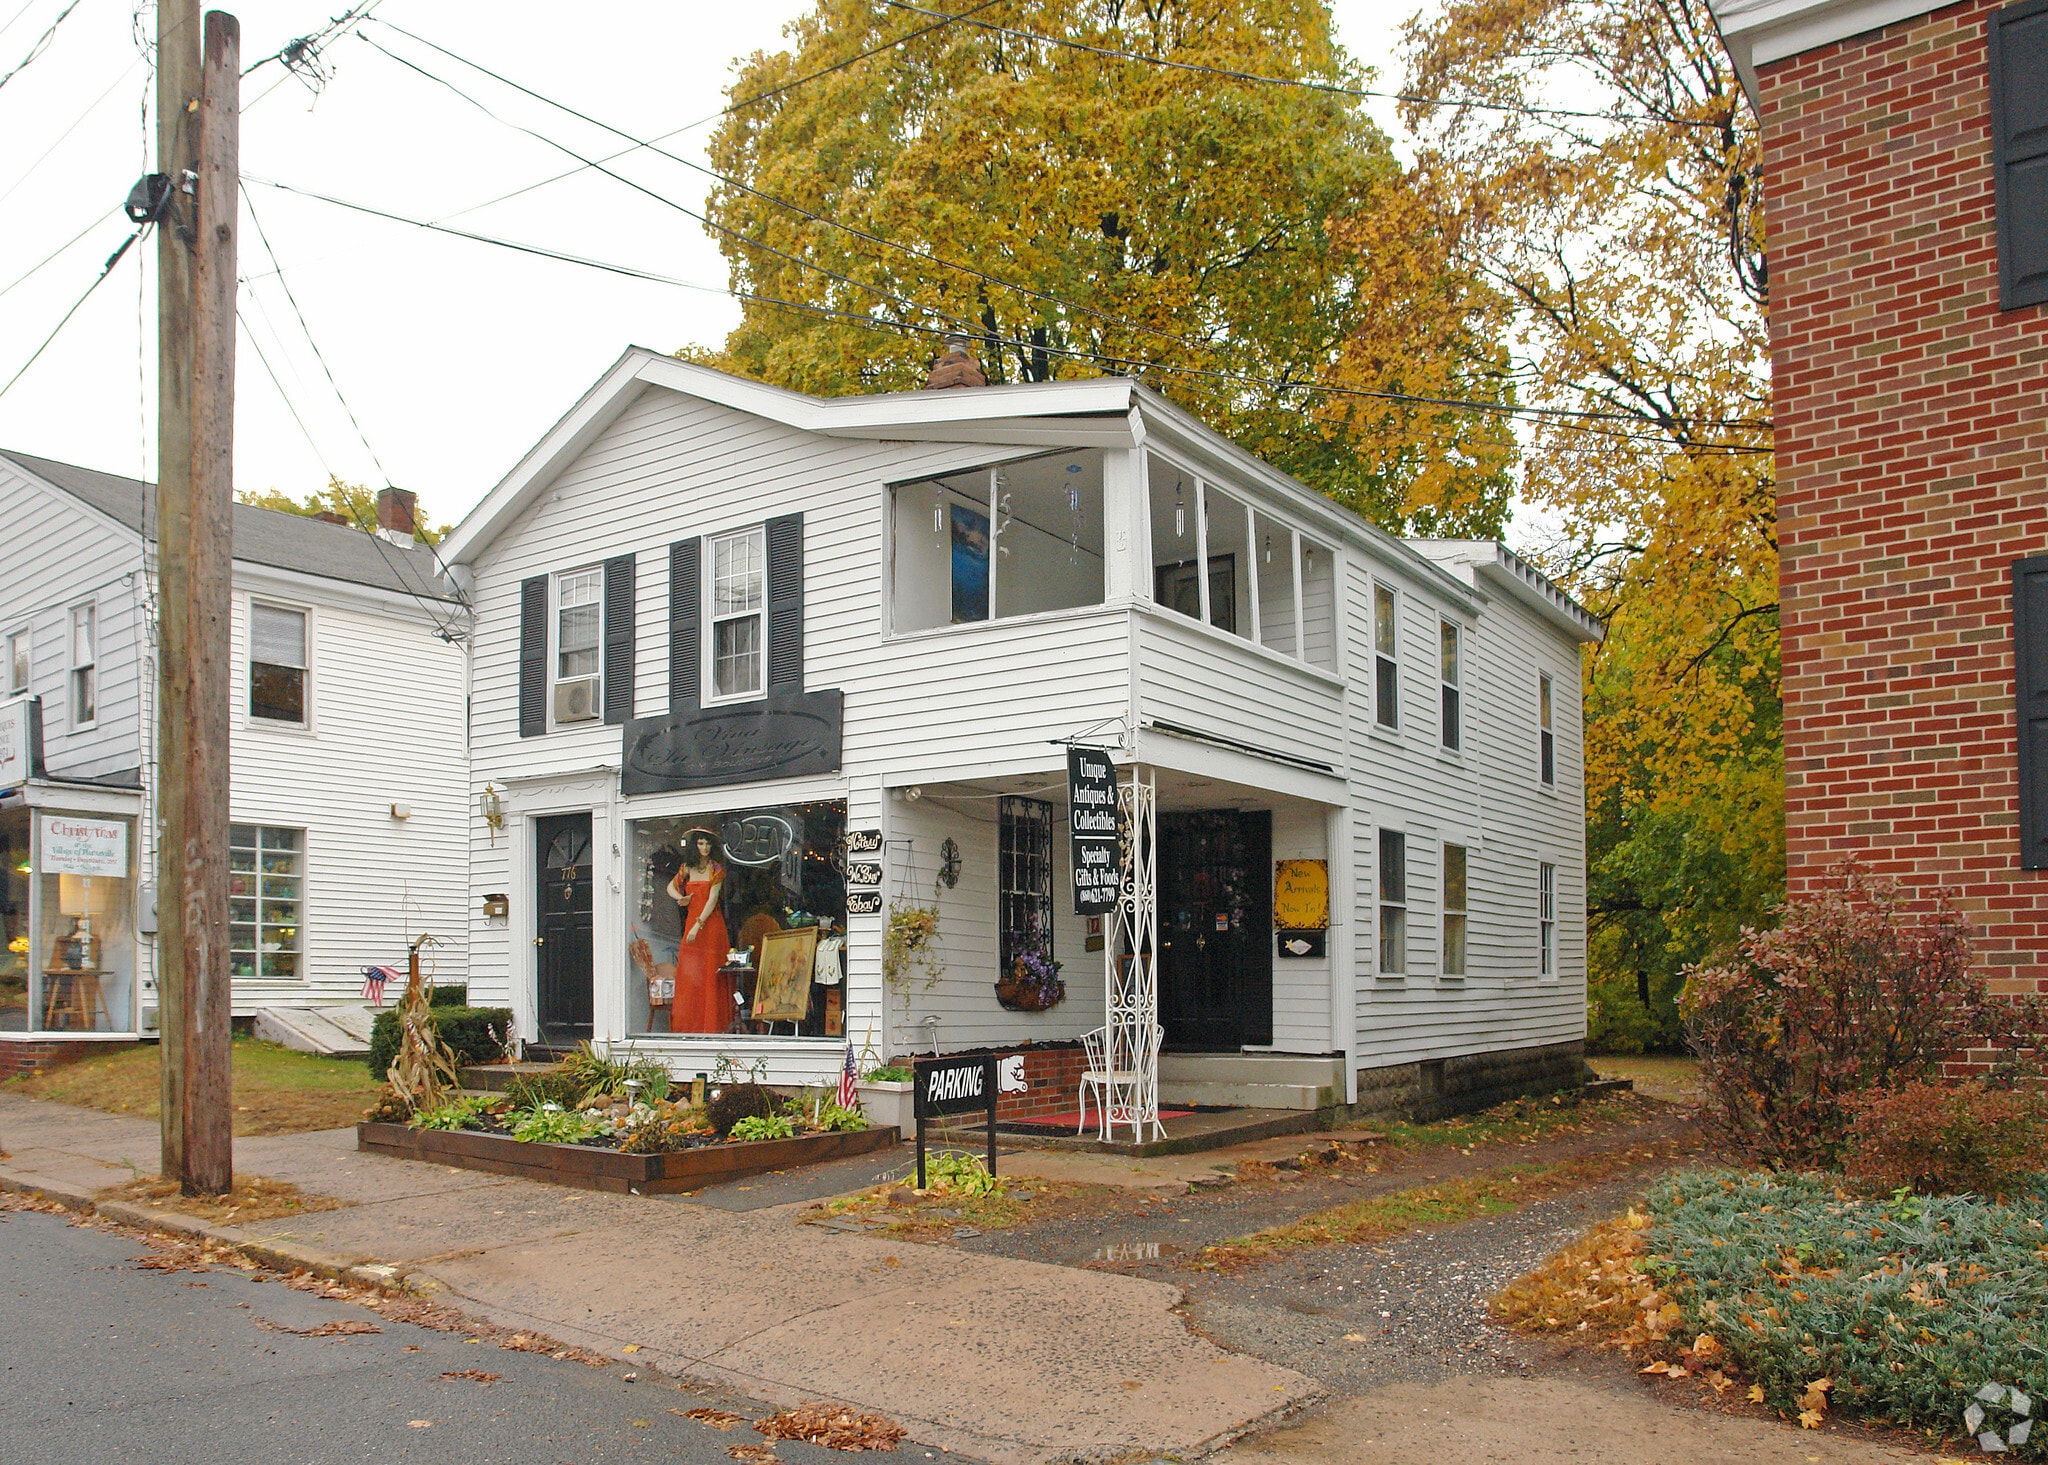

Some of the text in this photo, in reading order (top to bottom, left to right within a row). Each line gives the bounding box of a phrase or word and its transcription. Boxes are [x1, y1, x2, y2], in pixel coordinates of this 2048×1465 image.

[1079, 756, 1107, 783] Unique
[1073, 783, 1115, 809] Antiques &
[1073, 809, 1116, 831] Collectibles
[1081, 845, 1111, 868] Specialty
[561, 866, 576, 881] 776
[1075, 868, 1119, 887] Gifts & Foods
[1290, 868, 1310, 878] New
[927, 1065, 984, 1102] PARKING
